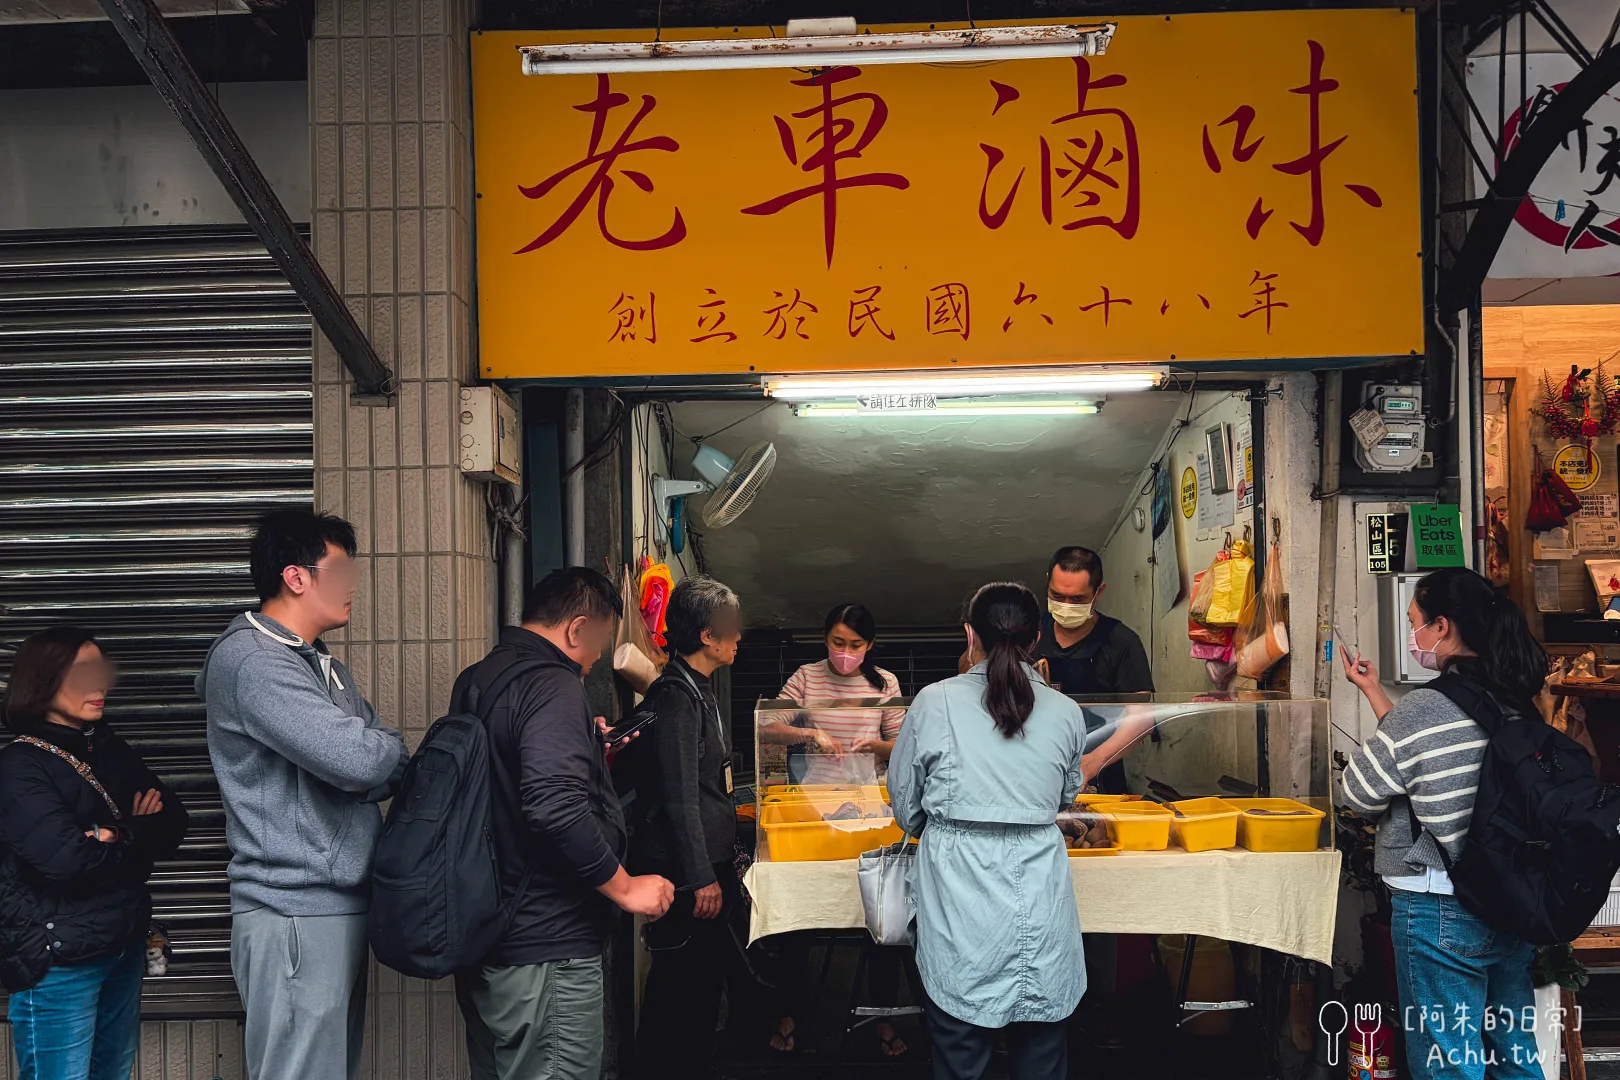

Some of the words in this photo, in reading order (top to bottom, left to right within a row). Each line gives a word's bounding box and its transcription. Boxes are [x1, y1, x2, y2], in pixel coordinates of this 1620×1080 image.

[512, 39, 1383, 270] 老車滷味
[607, 269, 1290, 345] 創立於民國六十八年
[1418, 514, 1453, 527] Uber
[1370, 516, 1383, 555] 松山區
[1420, 528, 1455, 541] Eats
[1421, 544, 1457, 556] 取餐區
[1370, 561, 1386, 569] 105
